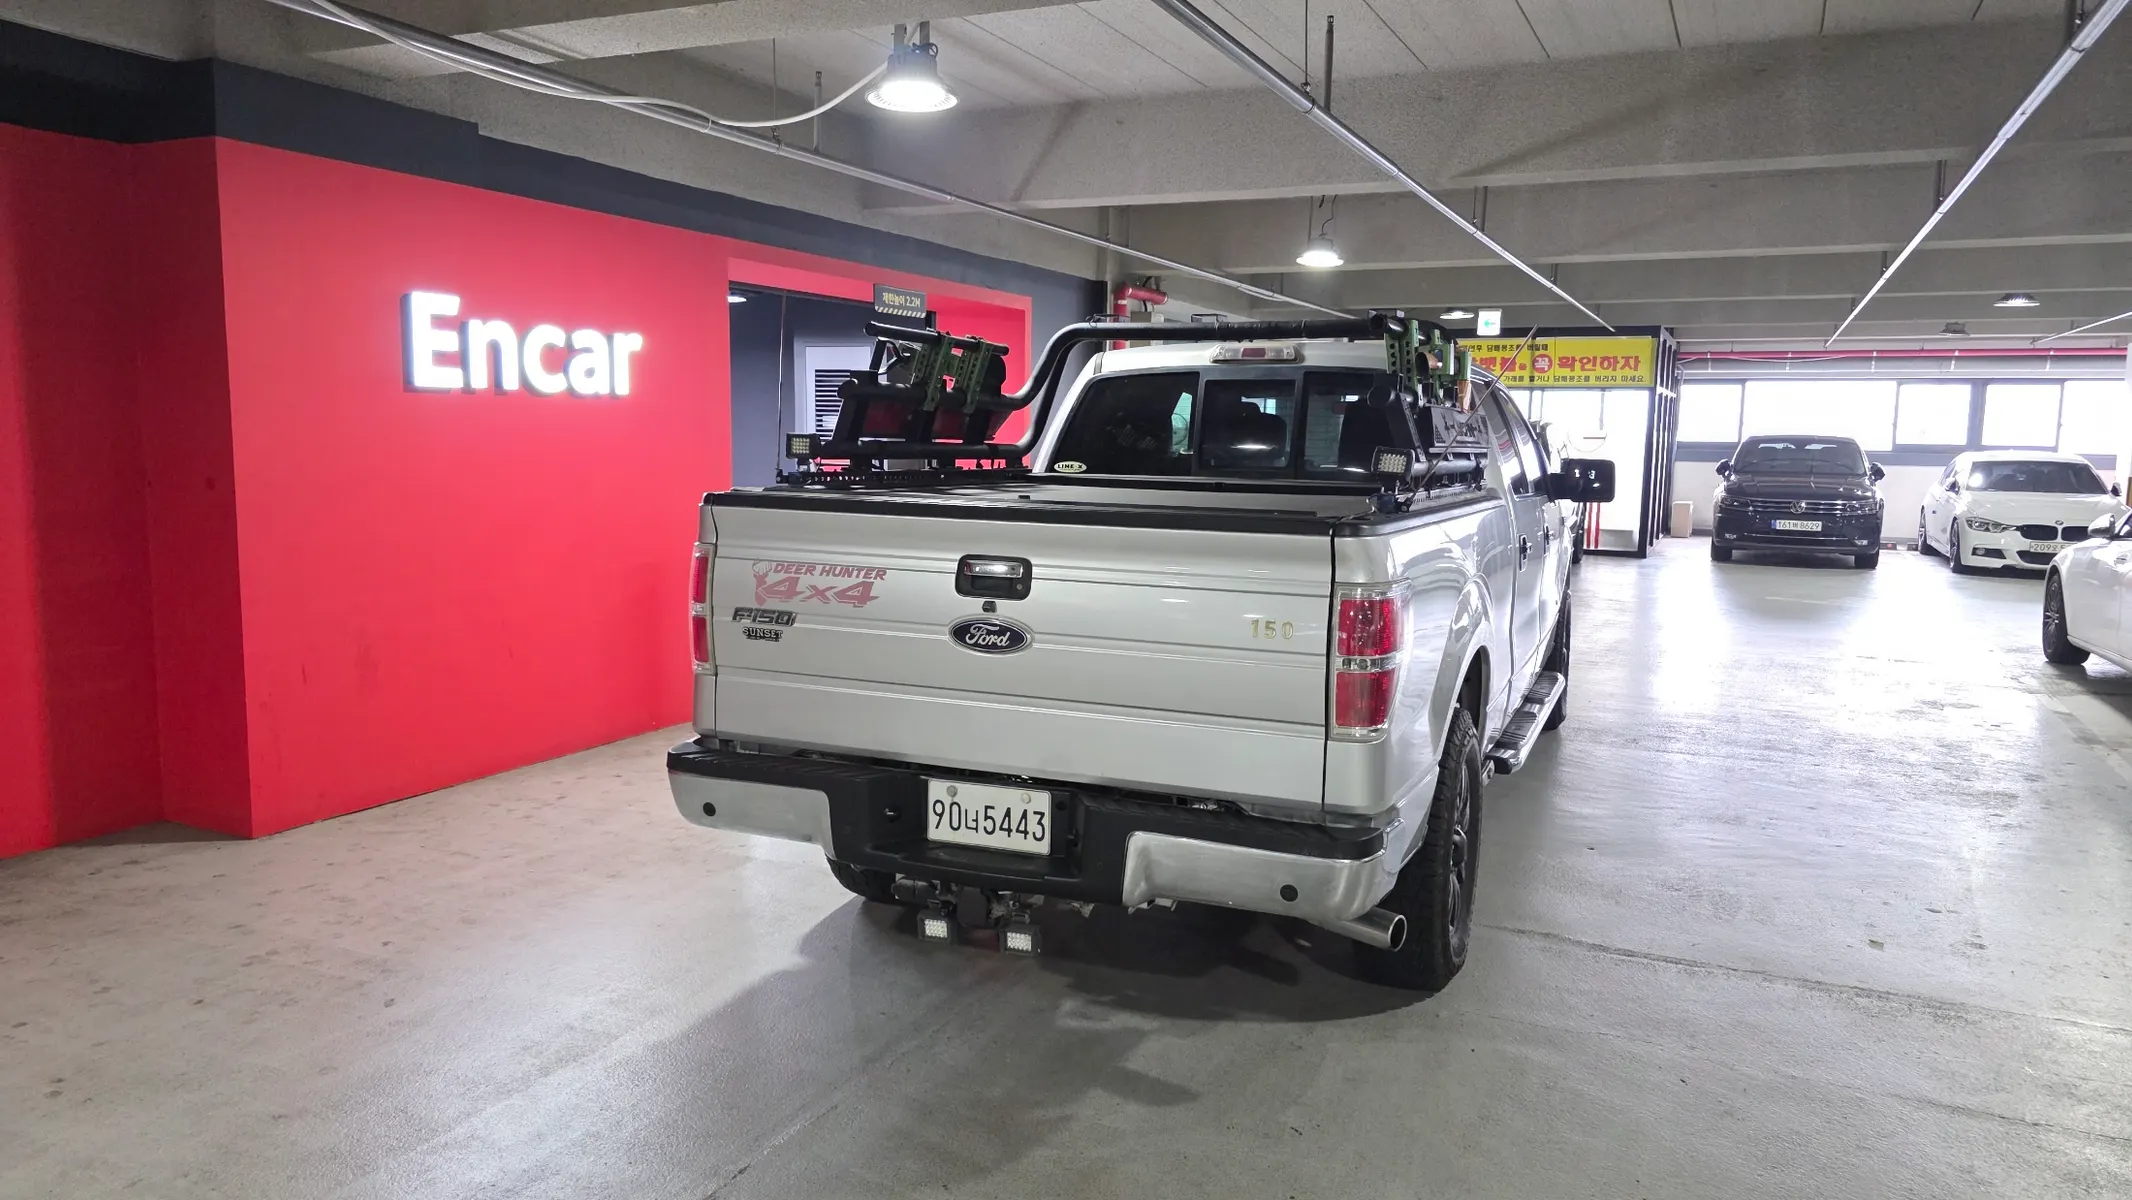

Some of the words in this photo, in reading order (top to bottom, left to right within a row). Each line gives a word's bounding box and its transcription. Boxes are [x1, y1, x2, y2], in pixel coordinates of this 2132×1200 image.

[882, 292, 905, 306] 제한높이
[906, 295, 921, 308] 2.2M
[402, 291, 643, 397] Encar
[1533, 356, 1551, 372] 꼭
[1557, 356, 1641, 372] 확인하자
[773, 562, 819, 577] DEER
[819, 565, 887, 581] HUNTER
[742, 626, 783, 639] SUNSET
[965, 623, 1011, 647] Ford
[1251, 619, 1293, 640] 150
[932, 799, 1046, 842] 90너5443
